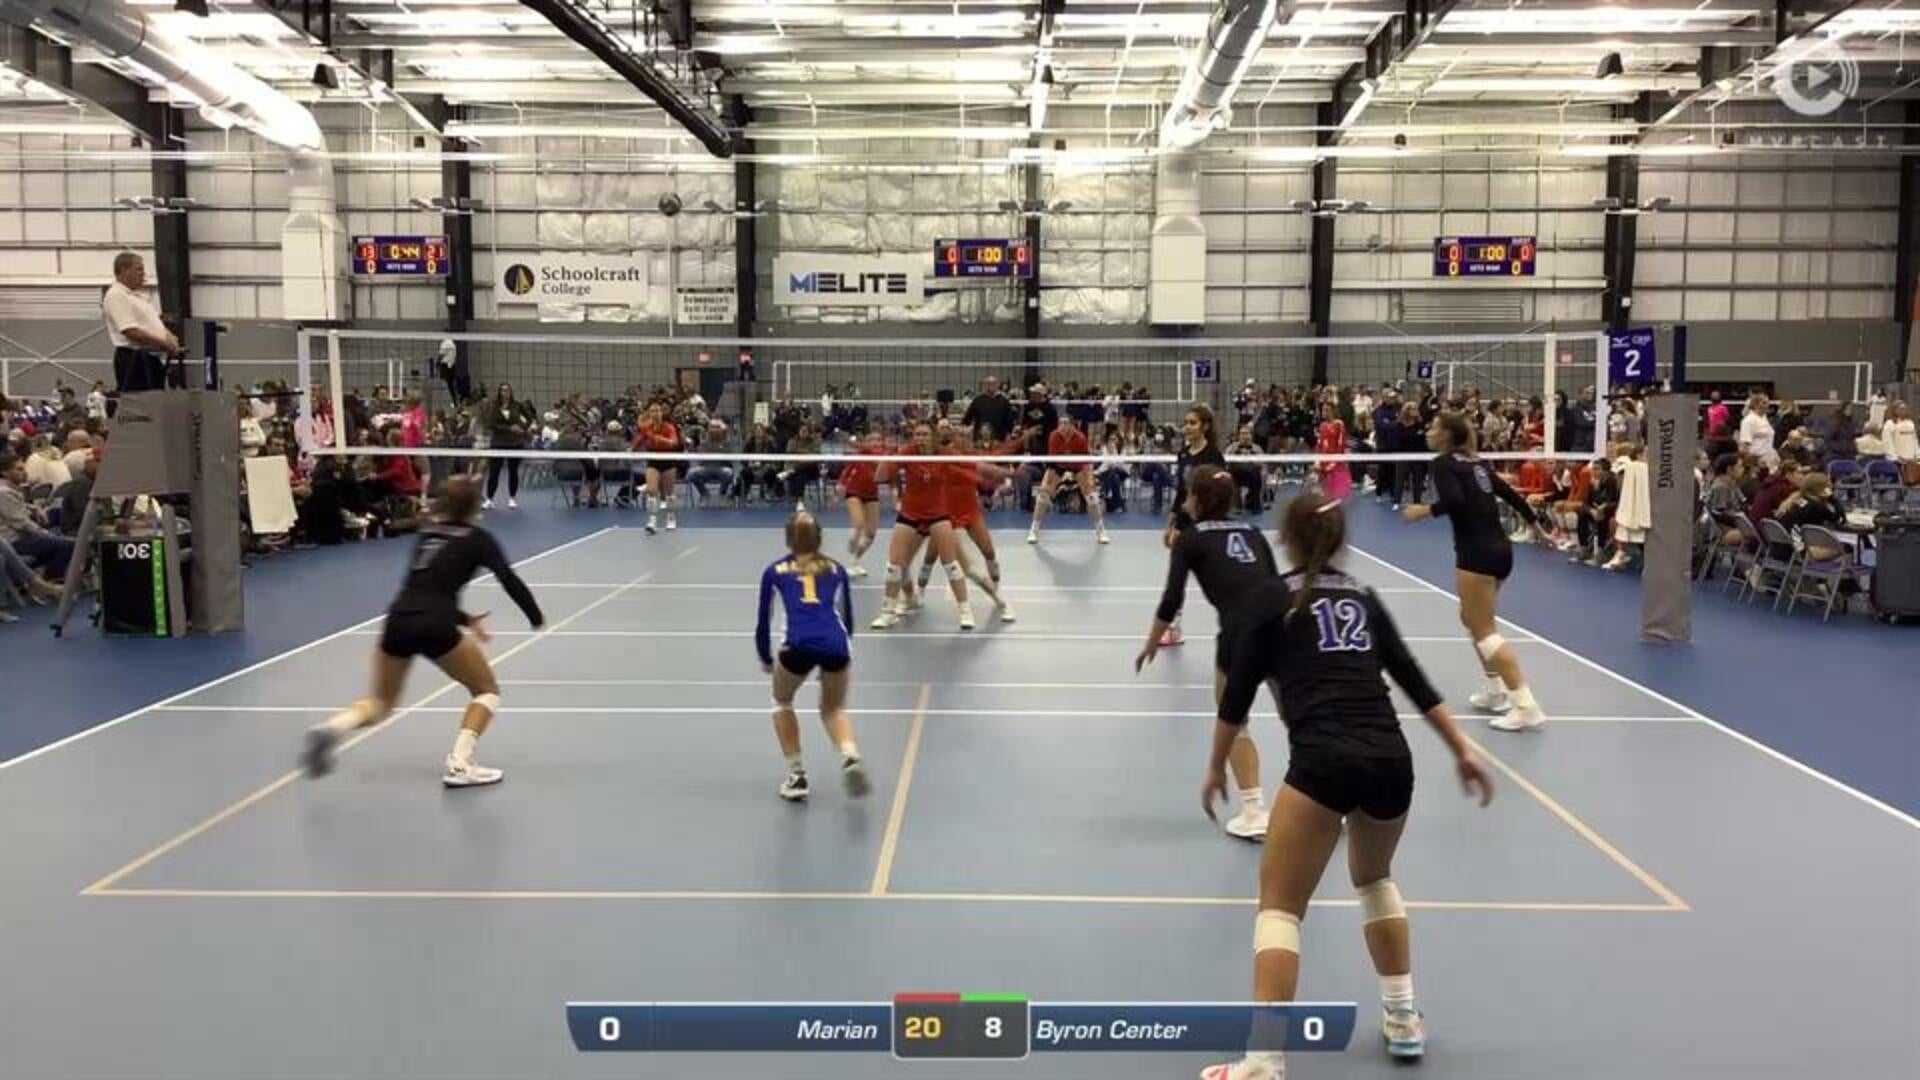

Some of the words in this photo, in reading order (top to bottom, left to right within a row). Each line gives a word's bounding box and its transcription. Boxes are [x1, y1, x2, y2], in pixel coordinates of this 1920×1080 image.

[362, 245, 376, 259] 13
[427, 244, 444, 259] 21
[947, 246, 957, 263] 0
[1017, 246, 1025, 263] 0
[1449, 245, 1459, 261] 0
[1521, 245, 1530, 261] 0
[366, 259, 377, 274] 0
[427, 259, 437, 274] 0
[541, 265, 641, 282] Schoolcraft
[1449, 261, 1459, 275] 0
[1511, 261, 1521, 275] 0
[541, 283, 592, 296] College
[1624, 349, 1641, 377] 2
[1658, 419, 1675, 489] SPALDING
[1226, 532, 1257, 563] 4
[796, 575, 821, 604] 1
[1311, 597, 1371, 651] 12
